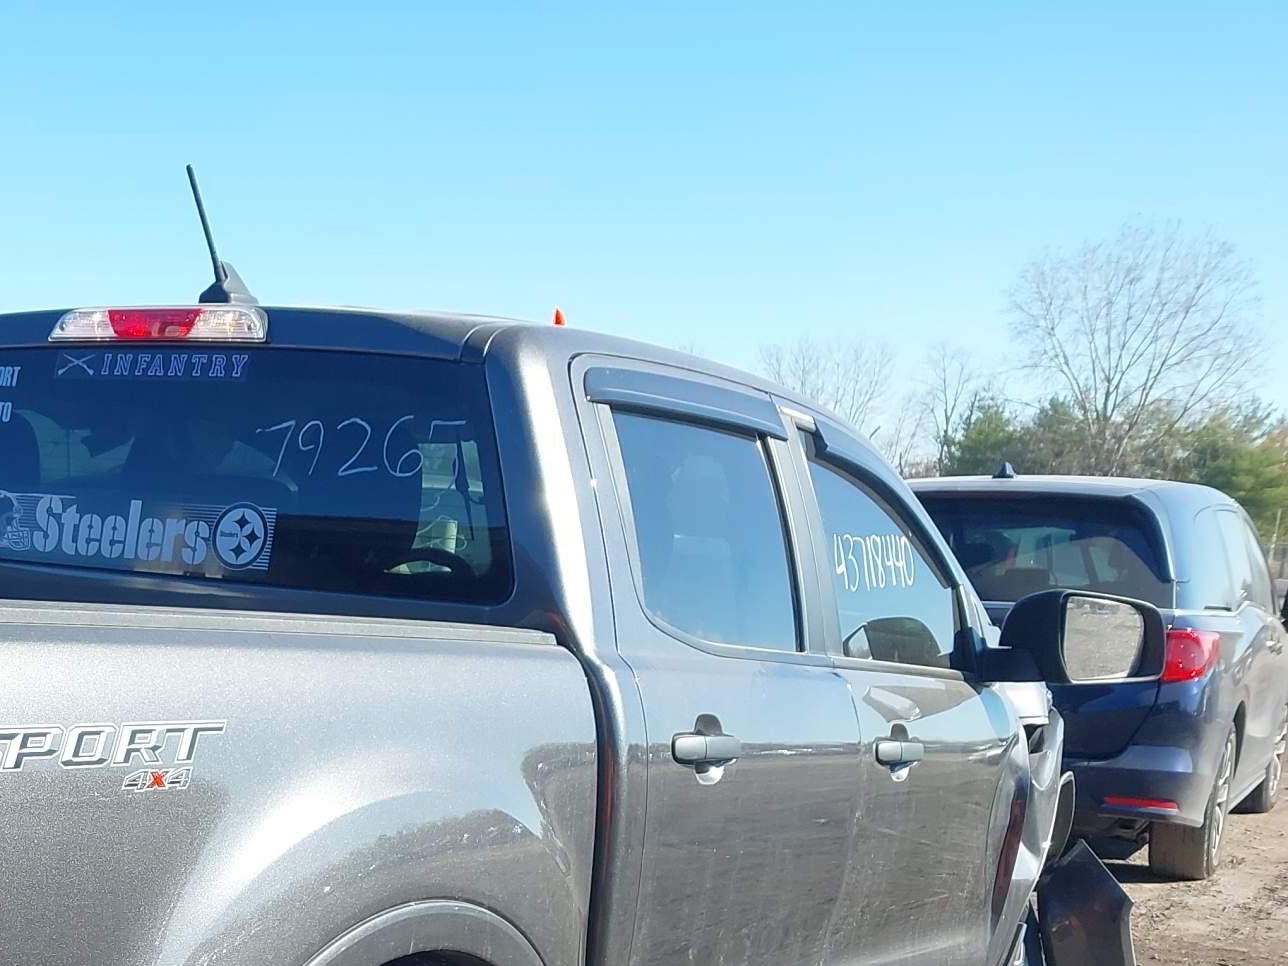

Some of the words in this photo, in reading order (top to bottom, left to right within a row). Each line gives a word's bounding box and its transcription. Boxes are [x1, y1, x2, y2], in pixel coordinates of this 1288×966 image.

[101, 353, 249, 377] INFANTRY
[32, 495, 210, 565] Steelers
[833, 533, 915, 593] 43718440
